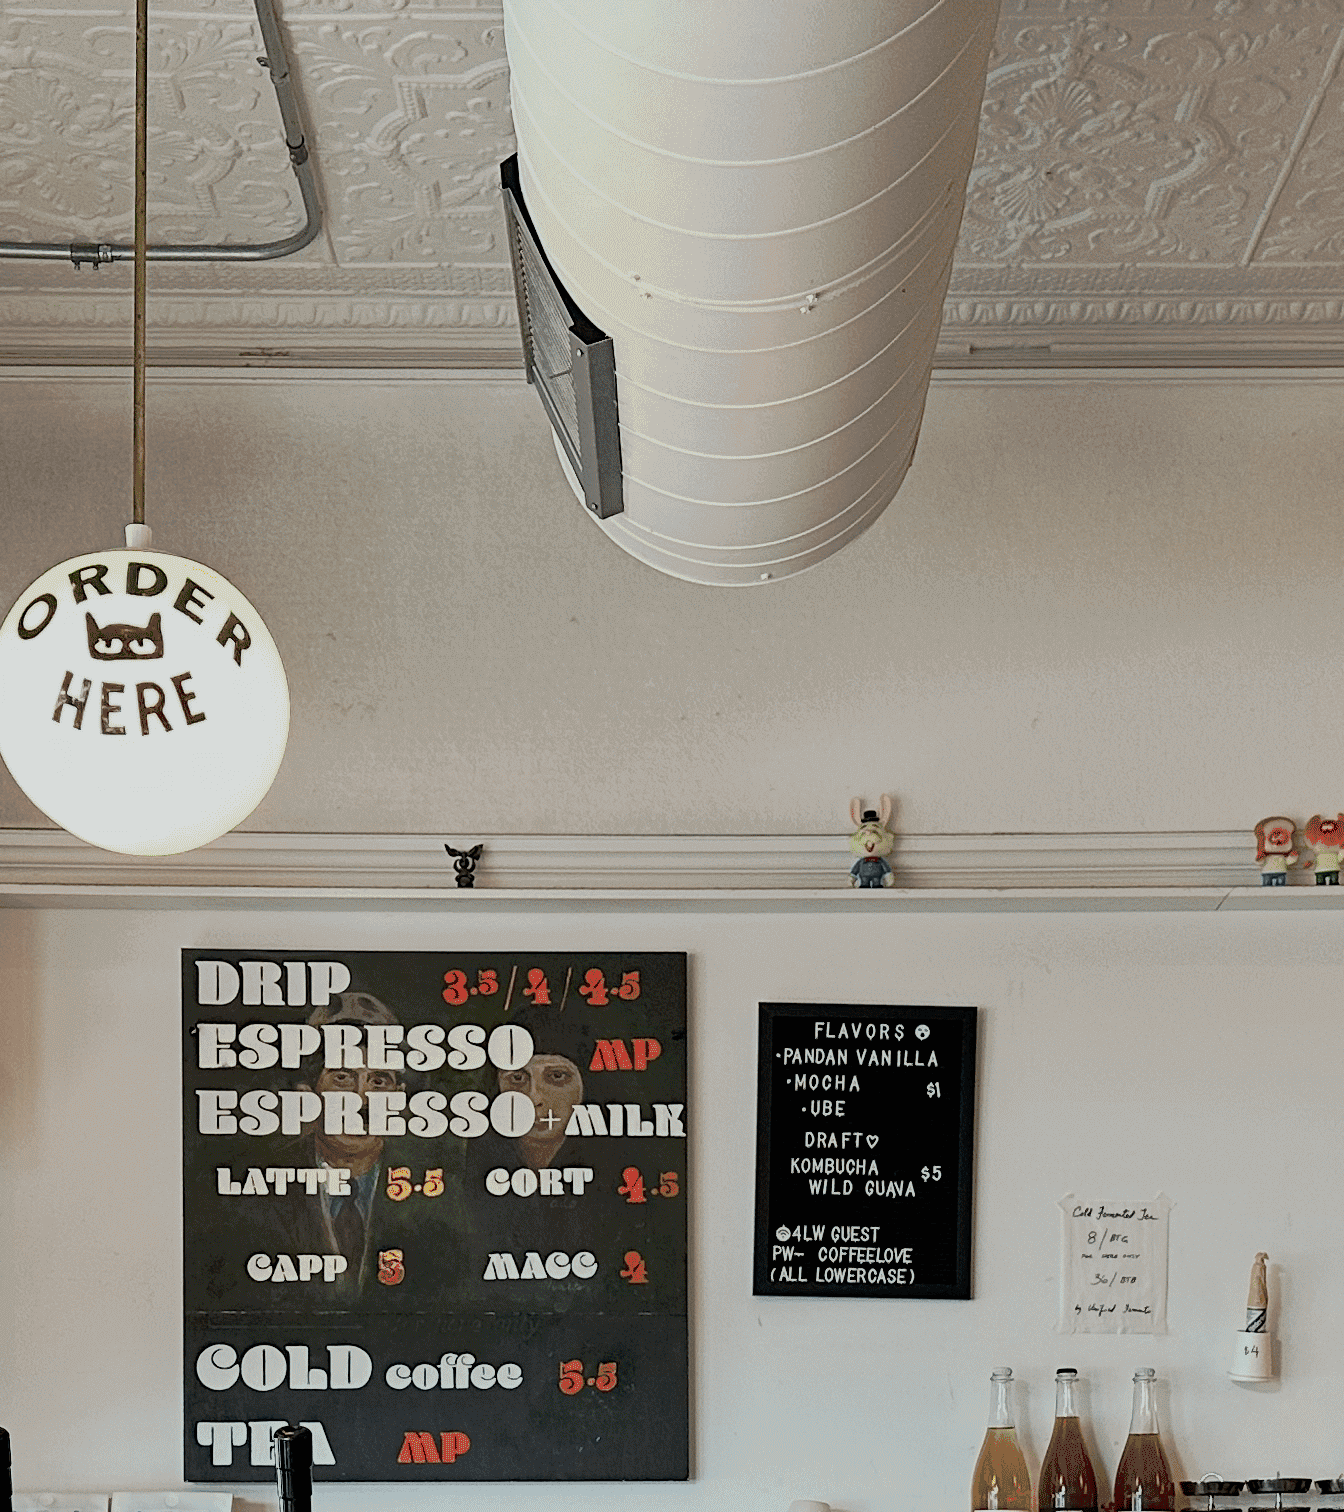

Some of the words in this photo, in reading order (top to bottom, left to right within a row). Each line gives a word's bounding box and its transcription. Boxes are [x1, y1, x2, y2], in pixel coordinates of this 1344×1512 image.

[17, 562, 252, 667] ORDER
[52, 670, 206, 736] HERE
[195, 961, 351, 1007] DRIP
[196, 1023, 534, 1071] ESPRESSO
[589, 1038, 661, 1071] MP
[814, 1022, 905, 1041] FLAVORS
[784, 1048, 848, 1066] PANDAN
[856, 1049, 938, 1067] VANILLA
[794, 1074, 860, 1092] MOCHA
[926, 1082, 941, 1098] $1
[196, 1090, 537, 1138] ESPRESSO
[566, 1103, 686, 1138] MILK
[810, 1100, 846, 1117] UBE
[805, 1132, 863, 1149] DRAFT
[216, 1167, 352, 1196] LATTE
[386, 1167, 446, 1201] 5.5
[486, 1167, 594, 1198] CORT
[618, 1166, 680, 1203] 4.5
[790, 1158, 878, 1175] KOMBUCHA
[920, 1165, 942, 1182] $5
[809, 1178, 853, 1196] WILD
[865, 1180, 915, 1198] GUAVA
[792, 1225, 825, 1242] 4LW
[831, 1226, 880, 1243] GUEST
[246, 1254, 348, 1283] CAPP
[378, 1249, 406, 1285] 5
[483, 1252, 598, 1281] MACC
[620, 1250, 649, 1284] 4
[818, 1247, 913, 1264] COFFEELOVE
[770, 1267, 807, 1282] (ALL
[816, 1267, 915, 1285] LOWERCASE)
[196, 1344, 372, 1391] COLD
[385, 1353, 523, 1389] coffee
[558, 1359, 619, 1396] 5.5
[397, 1431, 471, 1464] MP
